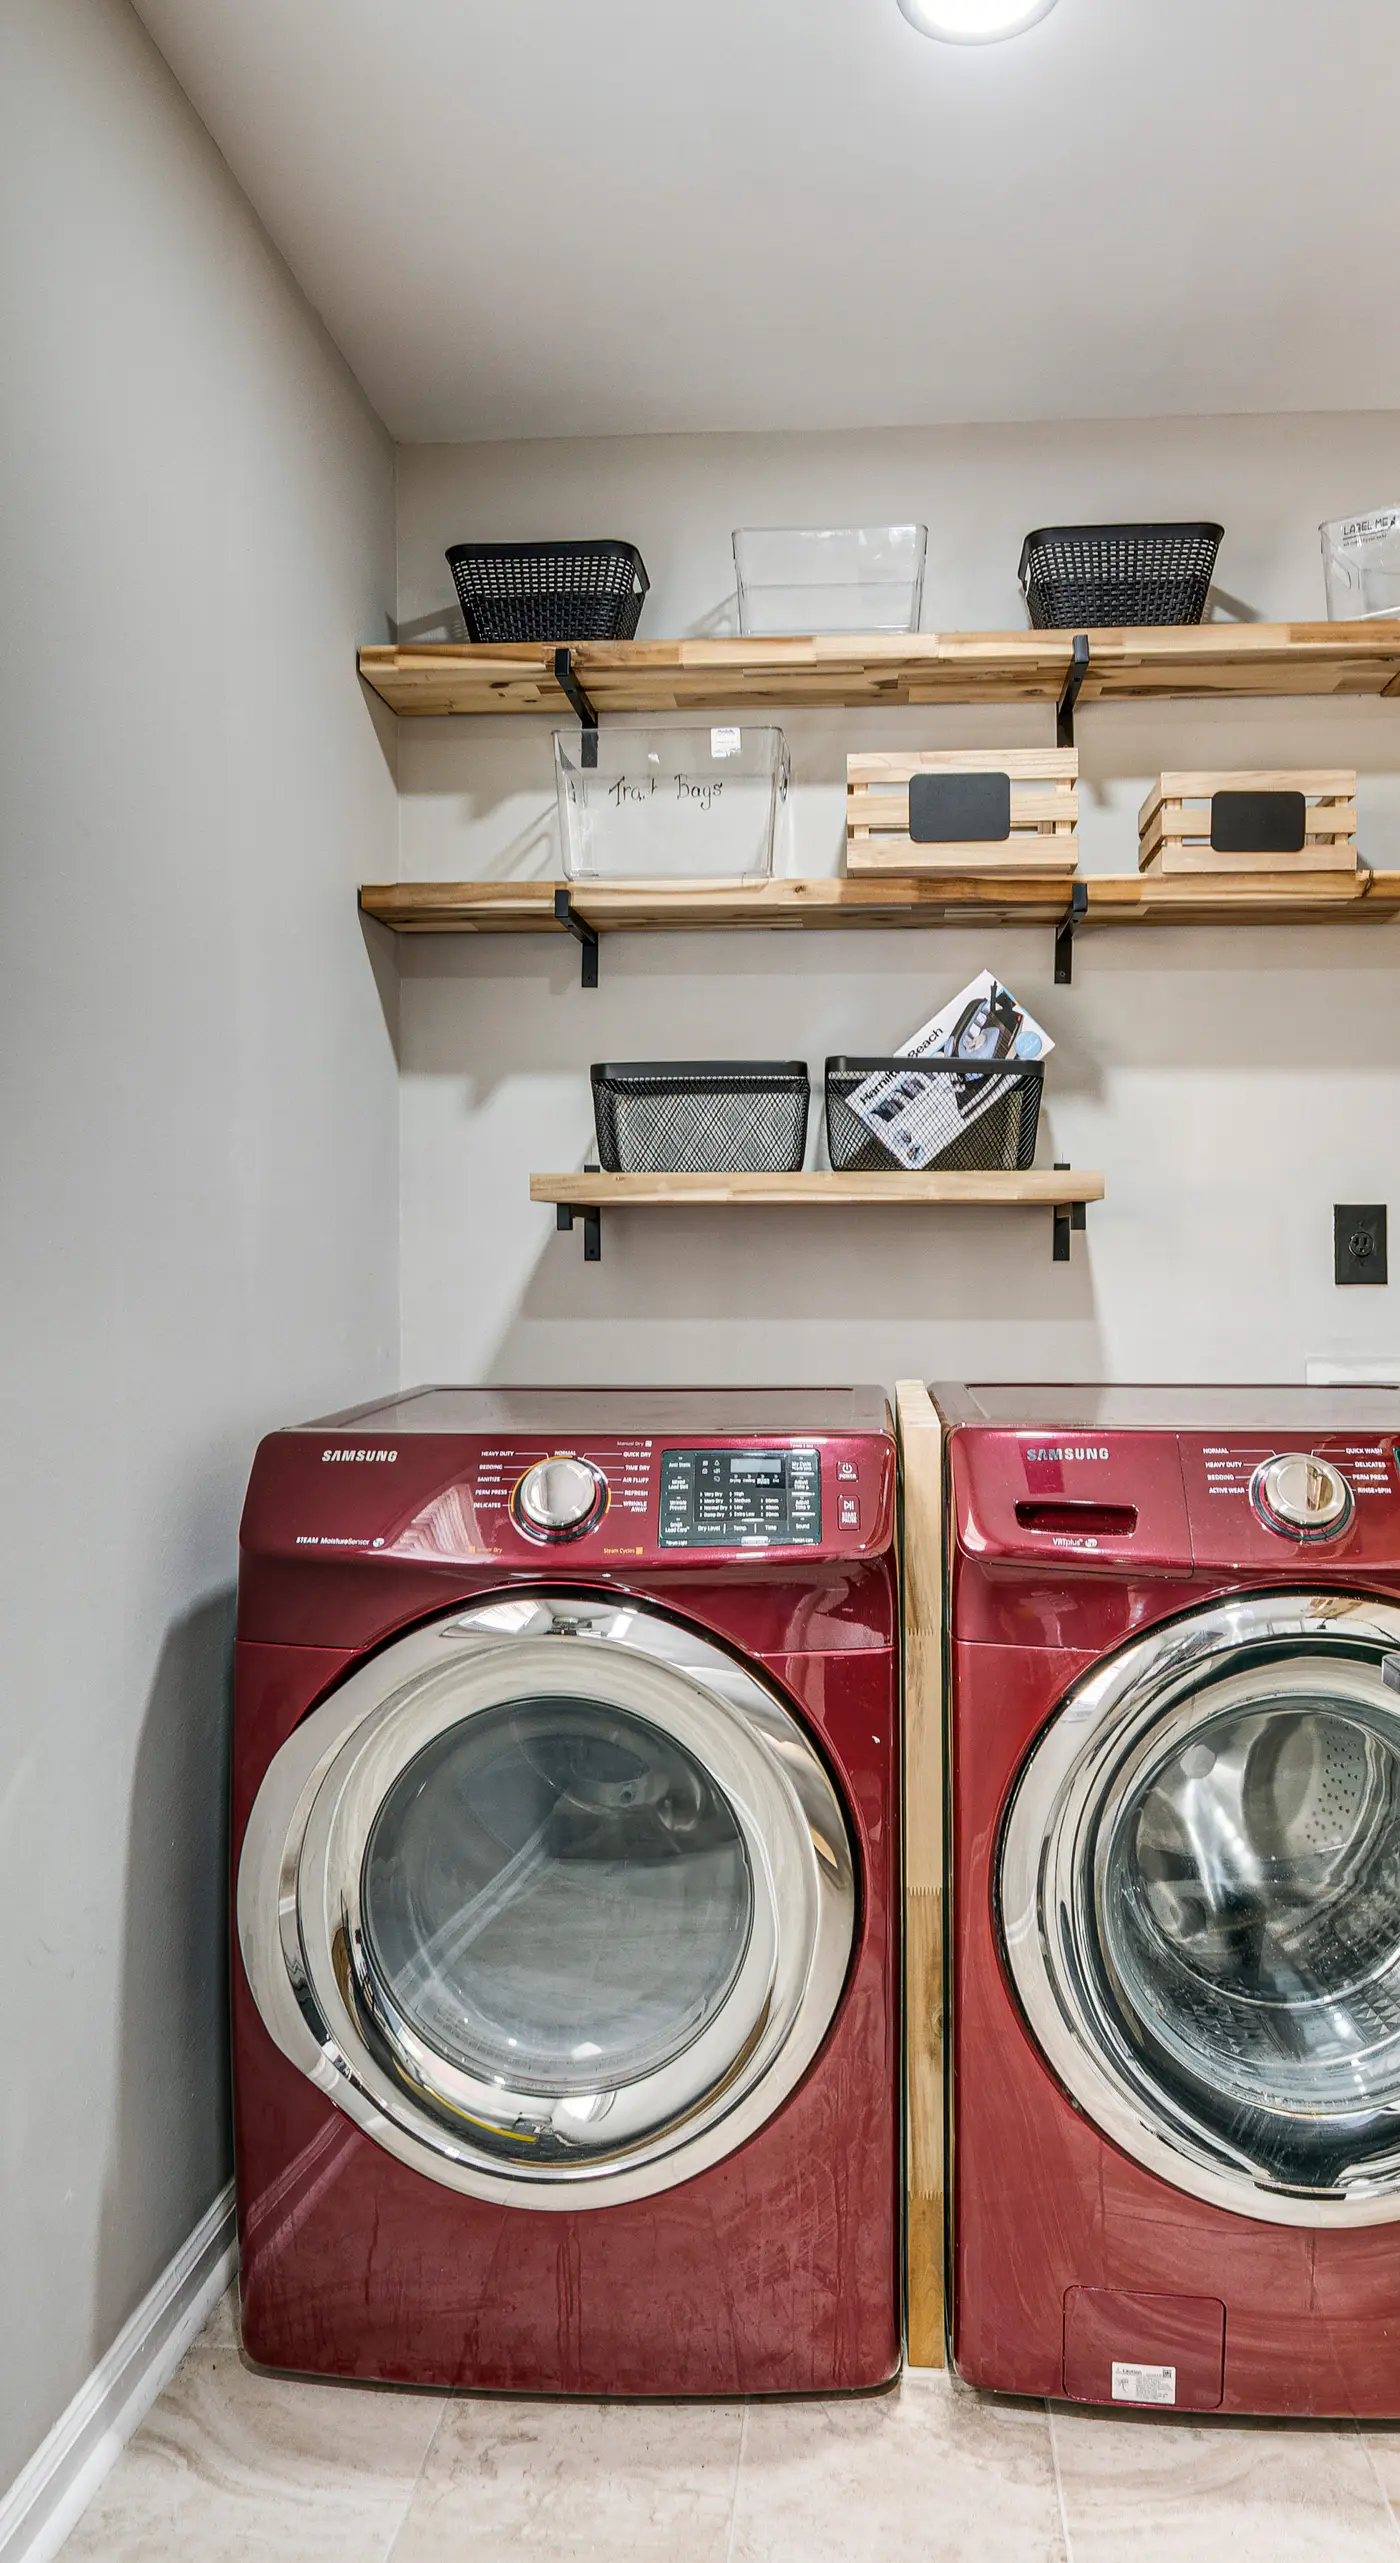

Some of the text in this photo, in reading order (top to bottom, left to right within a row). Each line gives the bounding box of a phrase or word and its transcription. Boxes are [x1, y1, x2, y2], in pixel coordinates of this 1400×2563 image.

[674, 773, 723, 811] Bags
[860, 1027, 944, 1105] Hamilt Beach
[321, 1449, 398, 1462] SAMSUNG
[1026, 1447, 1109, 1461] SAMSUNG
[296, 1536, 370, 1546] STEAM MoistureSensor
